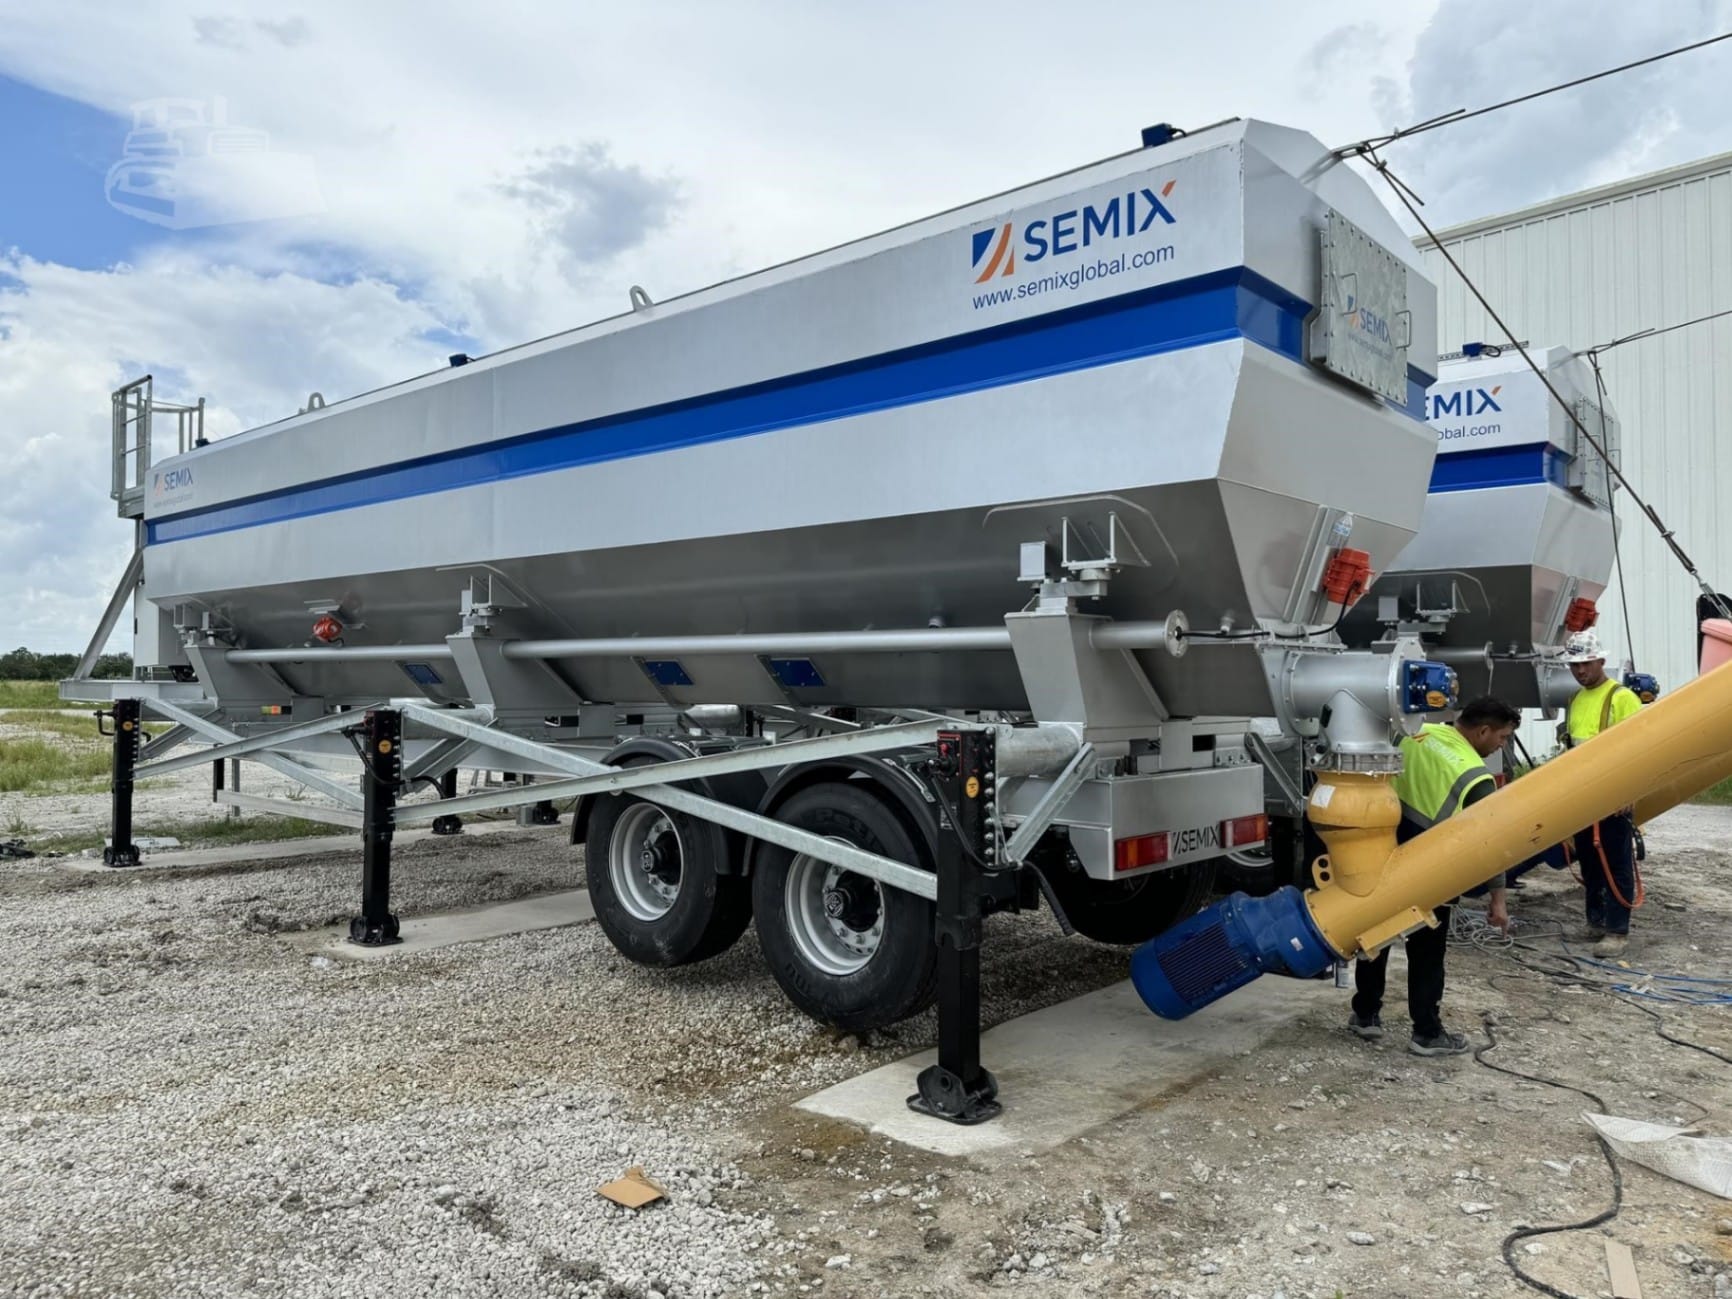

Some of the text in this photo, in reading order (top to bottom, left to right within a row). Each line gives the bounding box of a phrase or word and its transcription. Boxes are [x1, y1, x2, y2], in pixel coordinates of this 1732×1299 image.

[1023, 180, 1176, 262] SEMIX
[972, 245, 1174, 309] www.semixglobal.com
[1360, 307, 1393, 346] SEMIX
[164, 465, 193, 491] SEMIX
[1181, 825, 1219, 853] SEMIX
